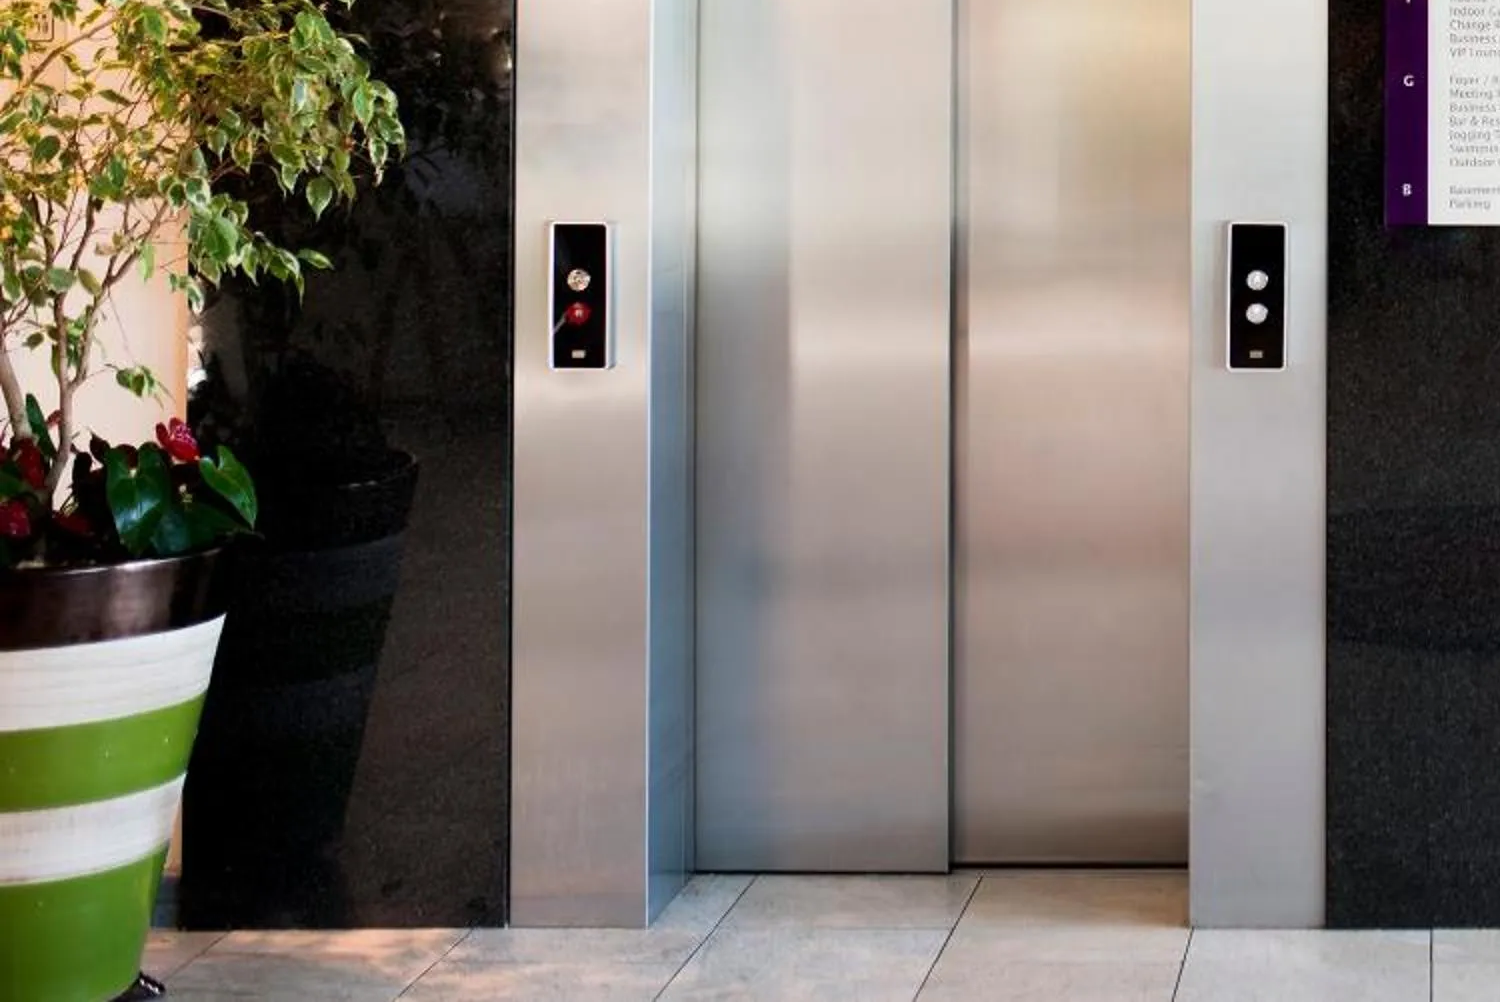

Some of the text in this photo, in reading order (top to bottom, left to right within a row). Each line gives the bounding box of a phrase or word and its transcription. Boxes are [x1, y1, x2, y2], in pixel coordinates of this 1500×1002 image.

[1449, 6, 1485, 17] Indoor
[1449, 20, 1491, 31] Change
[1449, 33, 1496, 43] Business
[1449, 47, 1466, 58] VIP
[1403, 75, 1414, 87] G
[1449, 76, 1480, 87] Foyer
[1449, 89, 1493, 100] Meeting
[1449, 103, 1496, 113] Business
[1449, 116, 1466, 126] Bar
[1470, 116, 1479, 126] &
[1449, 129, 1491, 141] Jogging
[1449, 157, 1495, 167] Outdoor
[1402, 183, 1412, 196] B
[1449, 185, 1500, 195] Basement
[1449, 199, 1491, 210] Parking
